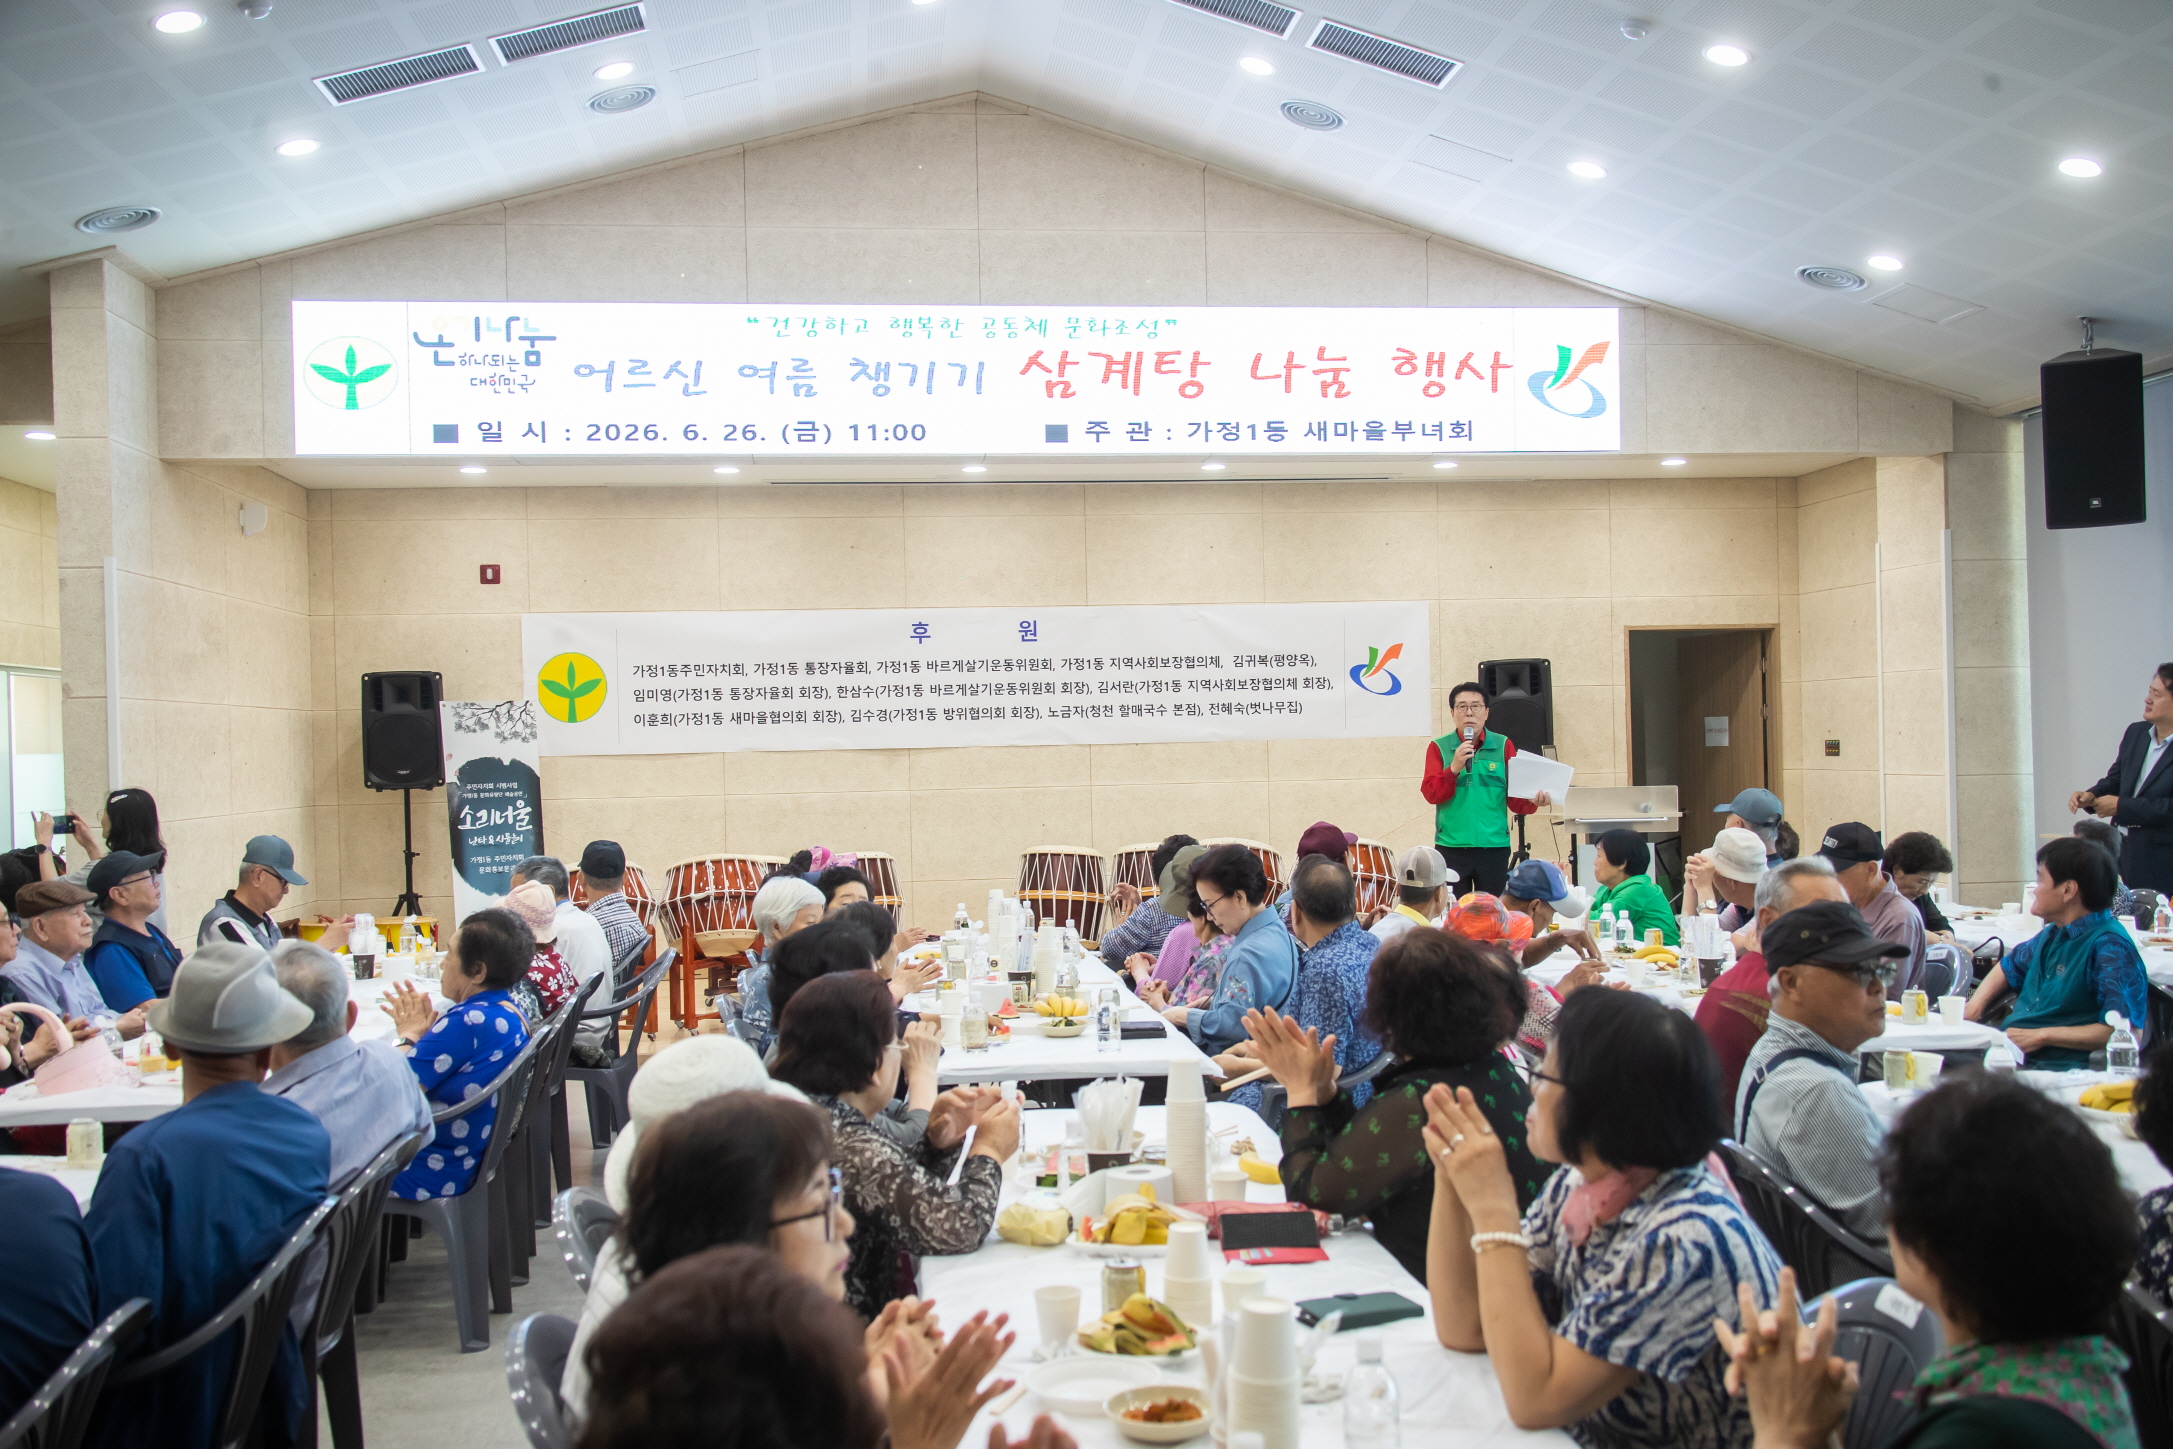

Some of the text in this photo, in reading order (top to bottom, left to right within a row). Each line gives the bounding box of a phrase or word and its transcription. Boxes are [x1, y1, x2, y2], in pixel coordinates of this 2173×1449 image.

[890, 317, 963, 339] 행복한
[983, 317, 1048, 338] 공동체
[458, 352, 520, 372] 하나되는
[574, 346, 1513, 399] 어르신 여름 챙기기 삼계탕 나눔 행사
[470, 373, 535, 393] 대한민국
[478, 421, 502, 442] 일
[522, 421, 545, 443] 시
[586, 424, 667, 441] 2026.
[683, 424, 707, 441] 6.
[724, 424, 765, 441] 26.
[782, 421, 831, 444] (금)
[849, 424, 926, 441] 11:00
[1085, 421, 1110, 443] 주
[1126, 421, 1152, 441] 관
[1188, 421, 1288, 442] 가정1동
[1304, 420, 1472, 442] 새마을부녀회
[910, 620, 1037, 644] 후 원
[633, 654, 1317, 678] 가정1동주민자치회, 가정1동 통장자율회, 가정1동 바르게살기운동위원회, 가정1동 지역사회보장협의체, 김귀복(평양옥),
[634, 677, 1333, 702] 임미영(가정1동 통장자율회 회장), 한삼수(가정1동 바르게살기운동위원회 회장), 김서란(가정1동 지역사회보장협의체 회장),
[634, 701, 1302, 727] 이훈희(가정1동 새마을협의회 회장), 김수경(가정1동 방위협의회 회장), 노금자(청천 할매국수 본점), 전혜숙(벗나무집)
[458, 799, 533, 830] 소리너울
